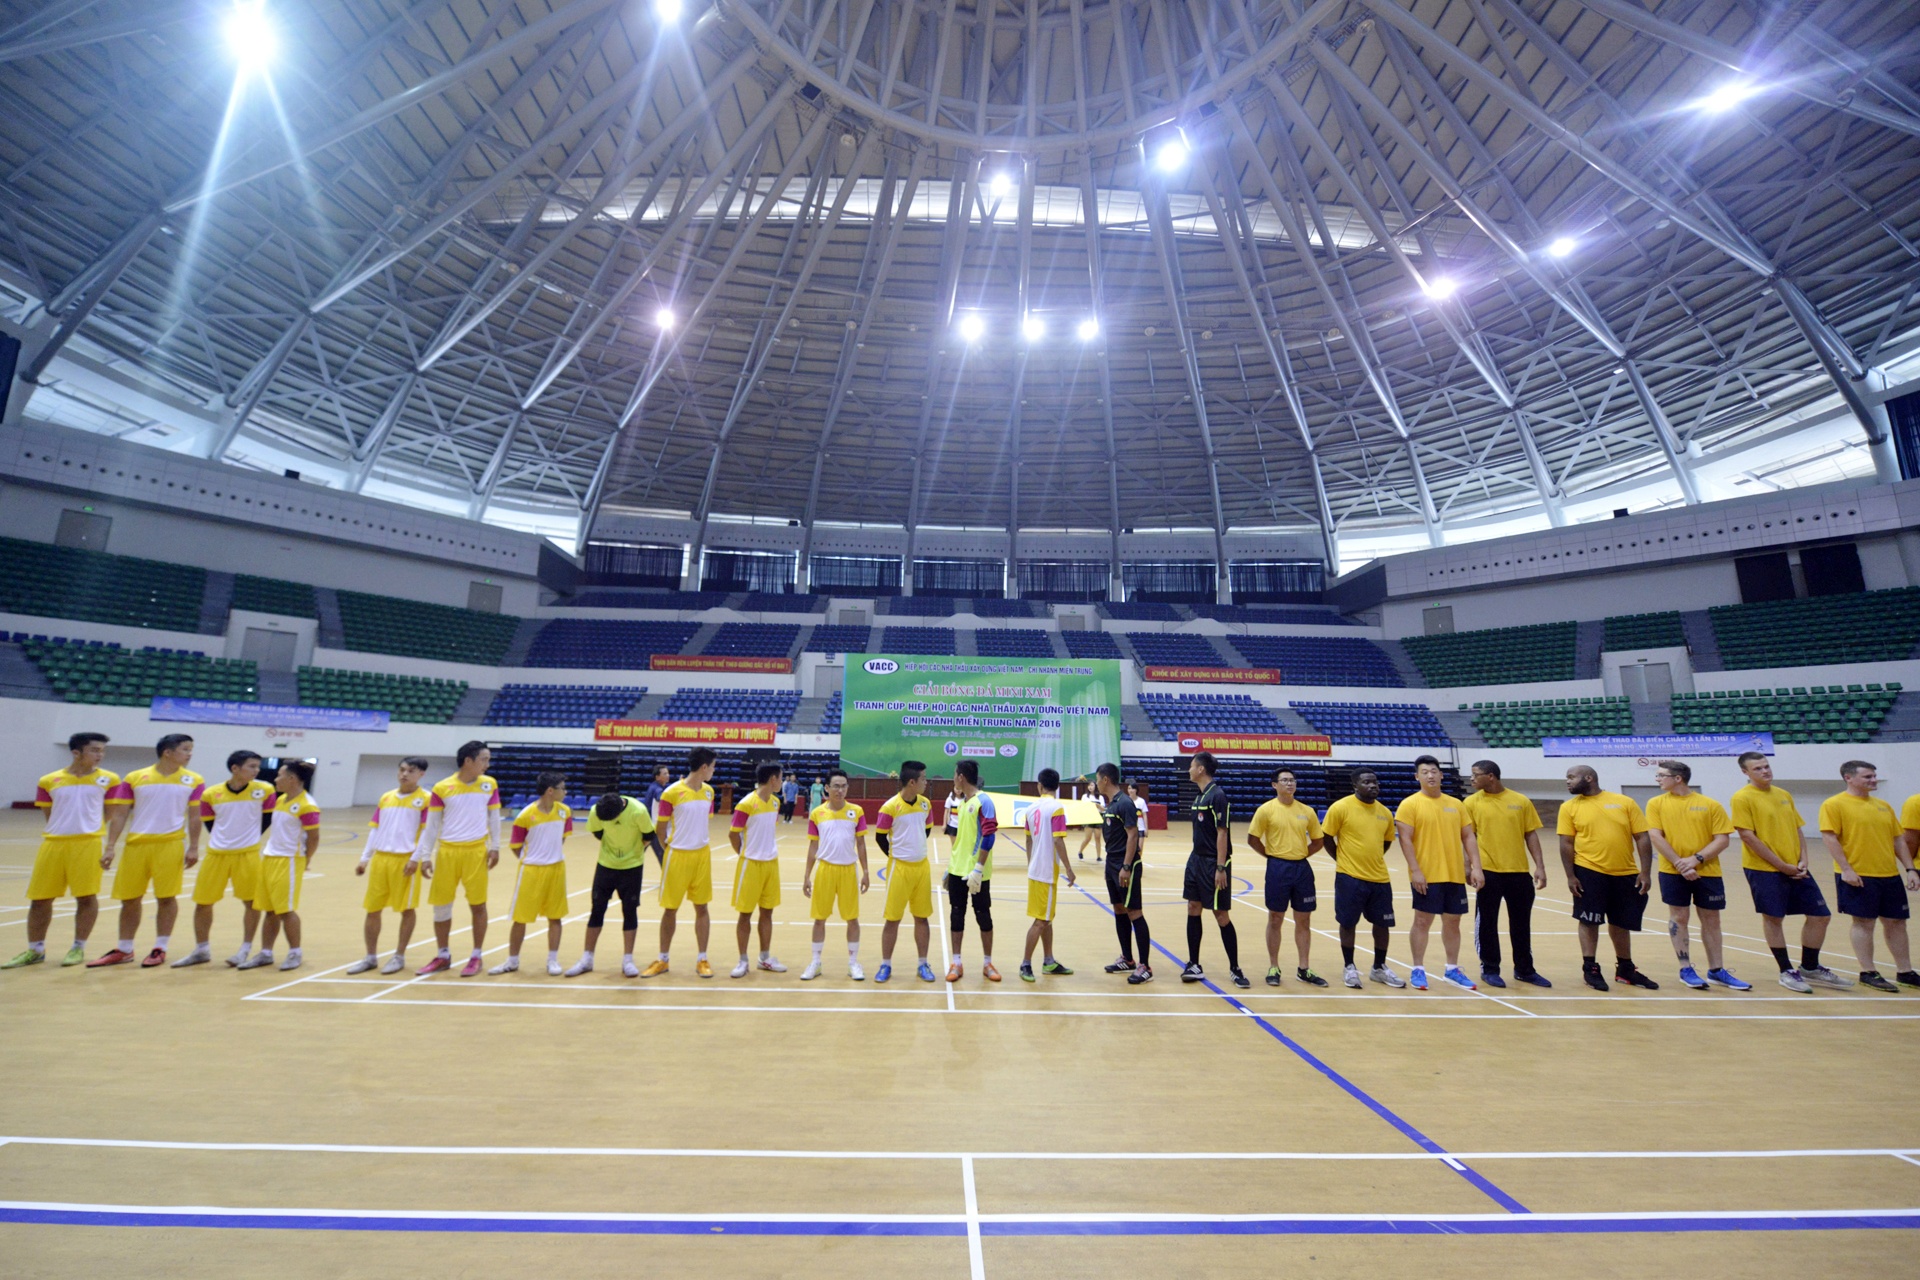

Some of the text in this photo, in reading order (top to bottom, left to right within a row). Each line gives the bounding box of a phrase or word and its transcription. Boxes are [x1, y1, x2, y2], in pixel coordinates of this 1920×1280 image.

[869, 662, 894, 670] VACC
[913, 680, 1052, 698] GIẢI BÓNG ĐÁ MINI NAM
[854, 701, 1109, 716] TRANH CÚP HIỆP HỘI CÁC NHÀ THẦU XÂY DỰNG VIỆT NAM
[902, 715, 1061, 728] CHI NHÁNH MIỀN TRUNG NĂM 2016
[598, 722, 614, 736] THỂ
[614, 726, 632, 737] THAO
[633, 724, 653, 737] ĐOÀN
[654, 724, 668, 738] KẾT
[675, 727, 698, 738] TRUNG
[700, 727, 718, 741] THỰC
[724, 728, 739, 739] CAO
[741, 728, 769, 742] THƯỢNG
[1202, 737, 1329, 752] CHÀO MỪNG NGÀY DOANH NHÂN VIỆT NAM 13/10 NĂM 2016
[1034, 808, 1041, 836] 9
[1580, 910, 1601, 923] AIR
